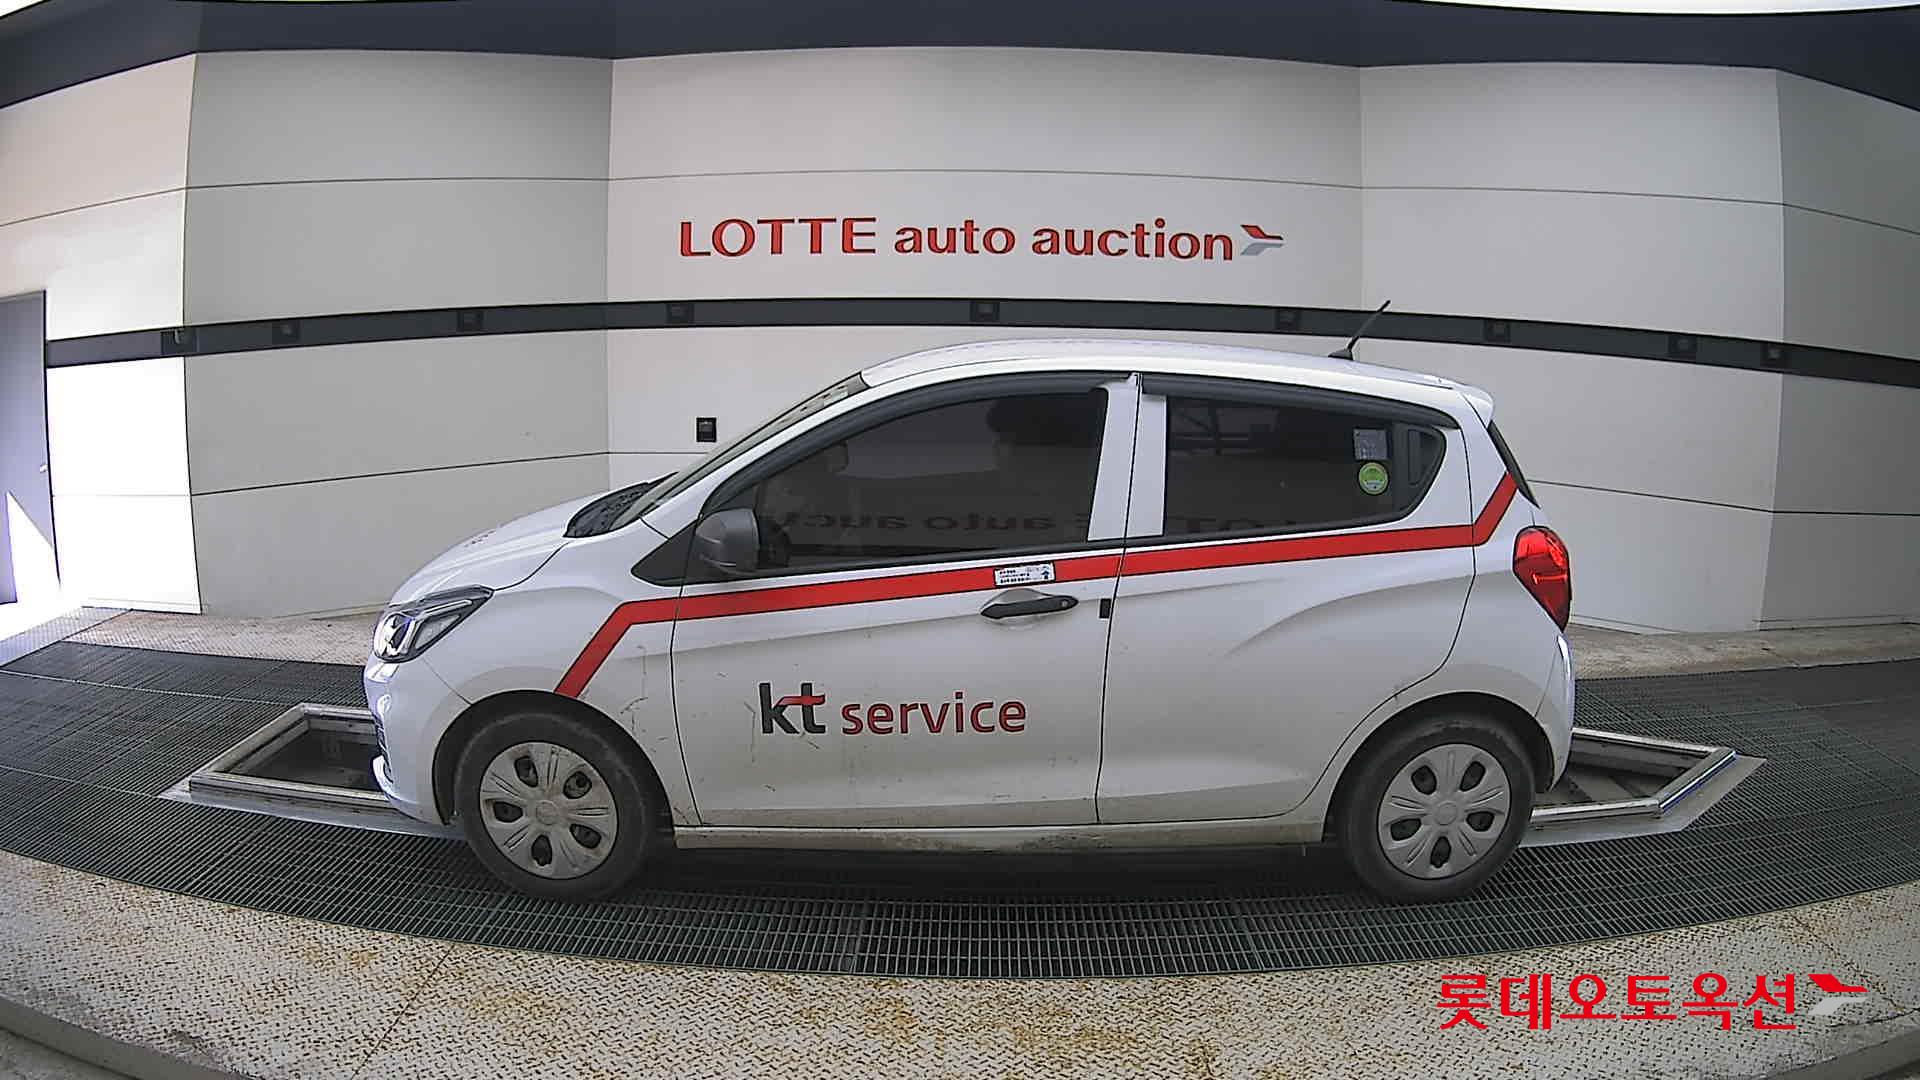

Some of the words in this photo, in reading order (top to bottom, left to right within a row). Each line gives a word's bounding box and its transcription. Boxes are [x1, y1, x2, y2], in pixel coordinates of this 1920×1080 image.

[681, 218, 876, 257] LOTTE
[894, 220, 1016, 255] auto
[1031, 218, 1233, 261] auction
[758, 682, 827, 735] kt
[840, 691, 1027, 735] service
